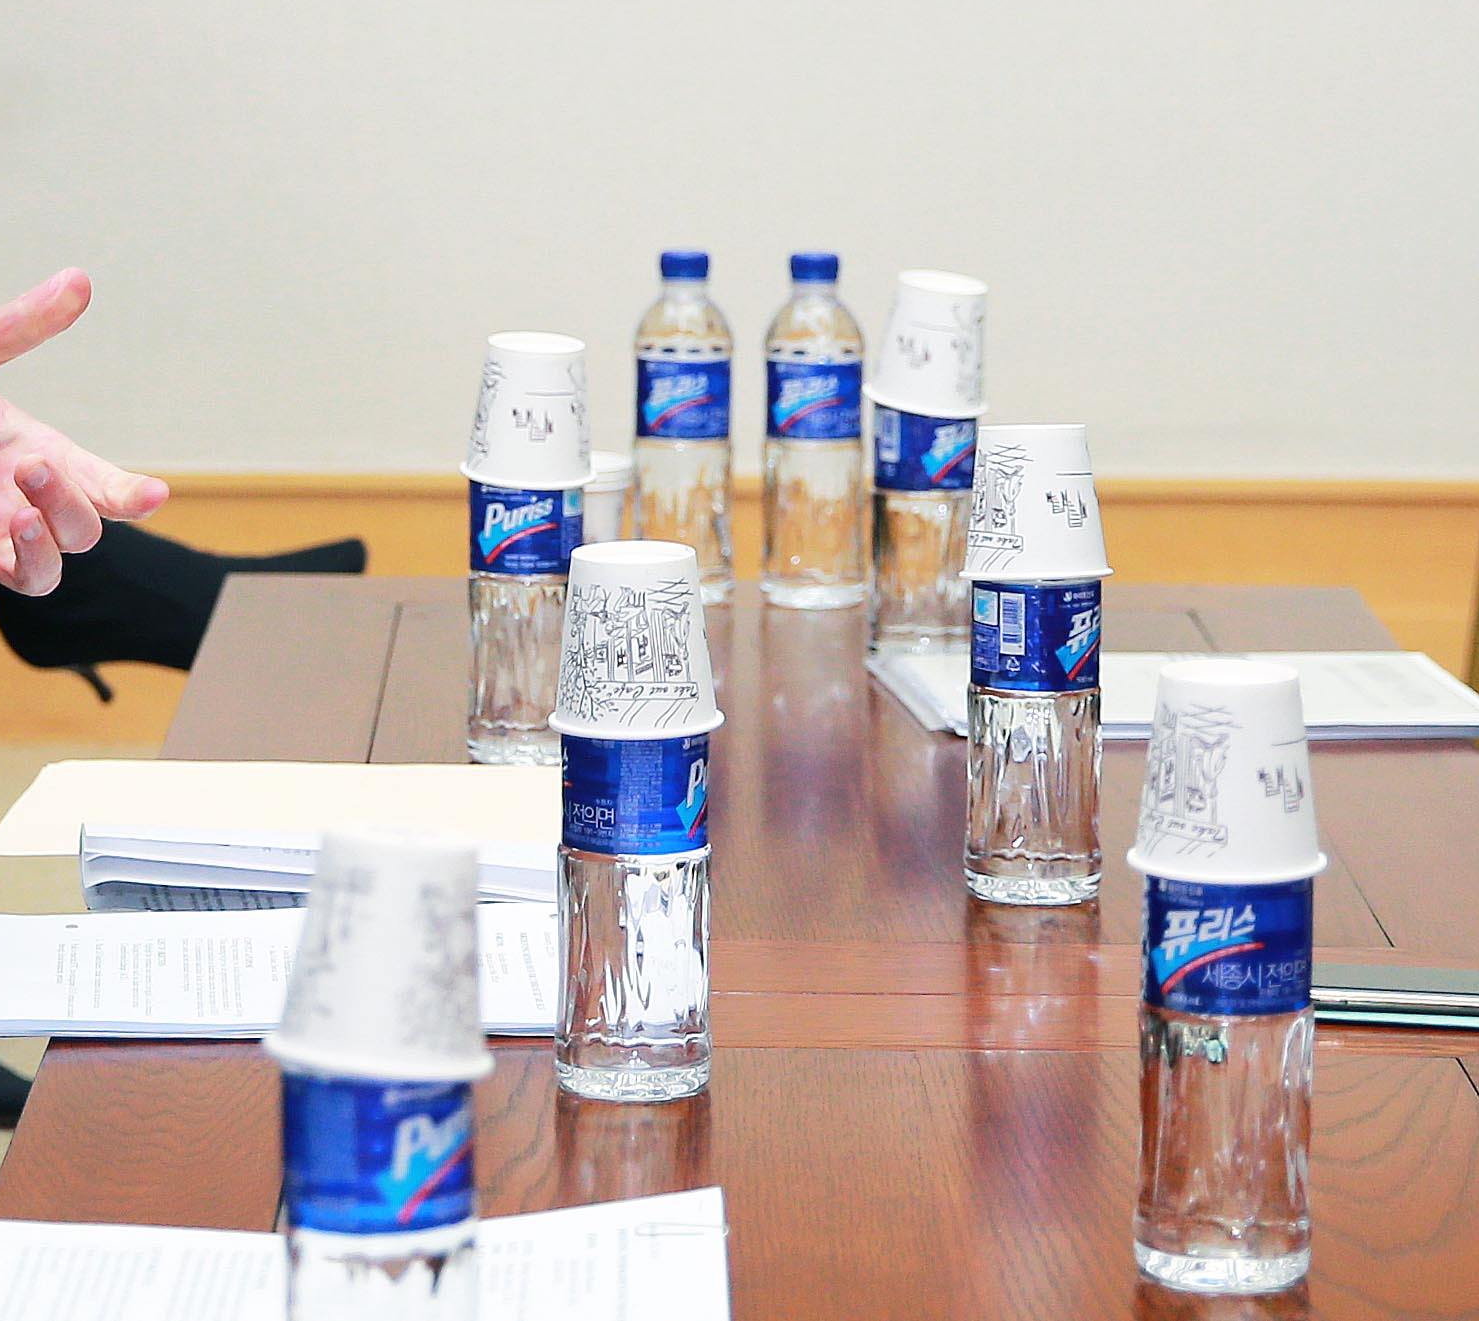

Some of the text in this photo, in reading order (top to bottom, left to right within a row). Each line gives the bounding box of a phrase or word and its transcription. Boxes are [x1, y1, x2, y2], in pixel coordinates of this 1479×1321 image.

[484, 495, 554, 538] Puriss
[572, 802, 615, 831] 전의면
[1160, 904, 1256, 961] 퓨리스
[1202, 962, 1262, 991] 세종시
